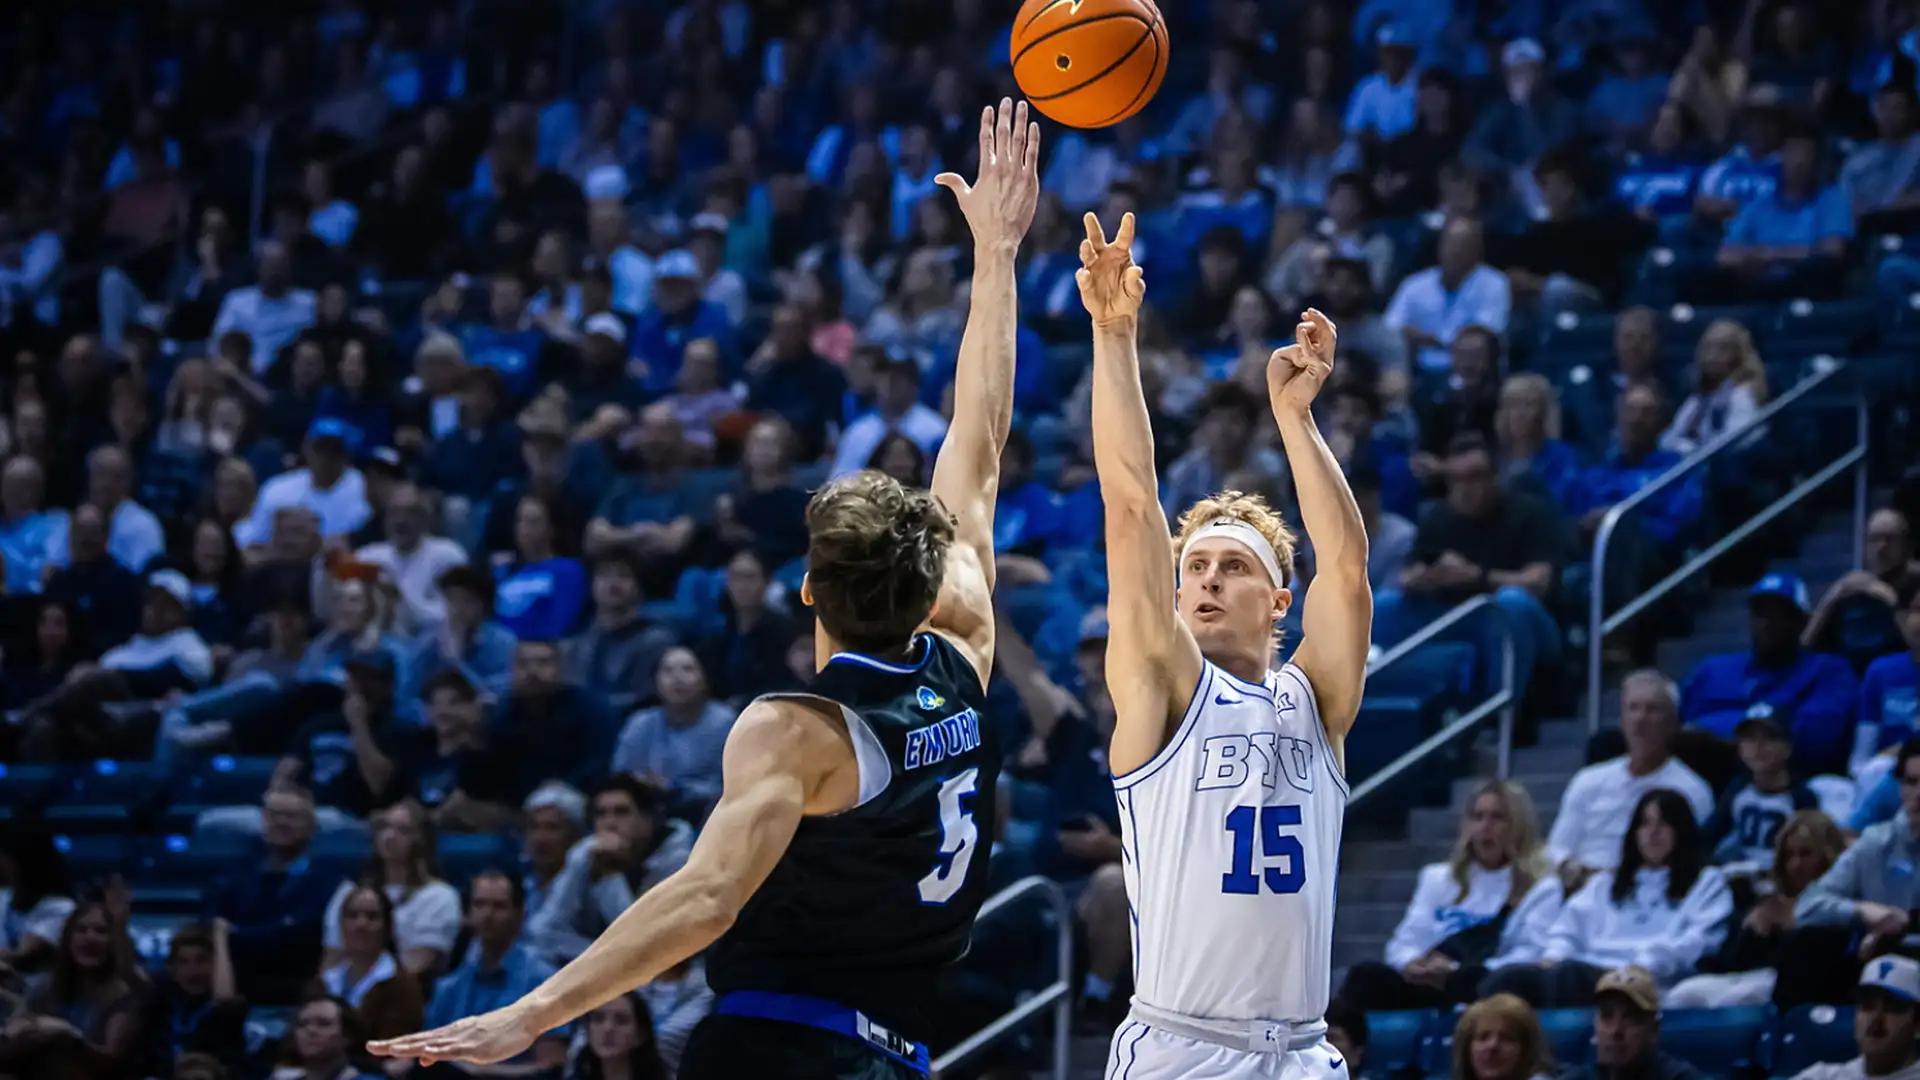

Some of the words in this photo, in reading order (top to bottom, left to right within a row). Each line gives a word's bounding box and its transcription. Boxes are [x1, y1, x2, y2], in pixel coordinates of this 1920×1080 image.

[1195, 732, 1314, 794] BYU
[917, 767, 979, 905] 5
[1221, 805, 1306, 894] 15
